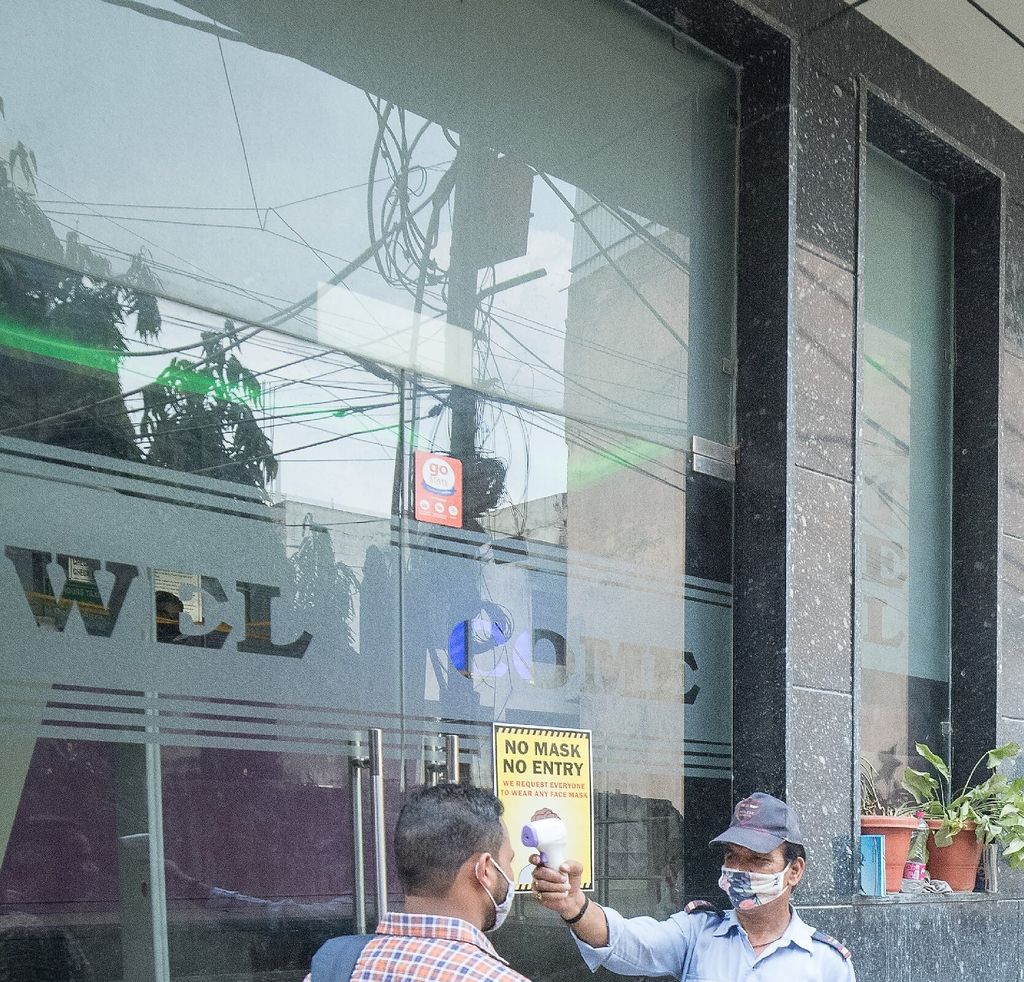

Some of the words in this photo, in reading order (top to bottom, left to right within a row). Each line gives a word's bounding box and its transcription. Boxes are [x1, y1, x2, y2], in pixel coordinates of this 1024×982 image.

[505, 739, 529, 755] NO
[534, 741, 581, 758] MASK
[503, 758, 527, 774] NO
[532, 760, 584, 776] ENTRY
[516, 780, 548, 788] REQUEST
[550, 781, 585, 790] EVERYONE
